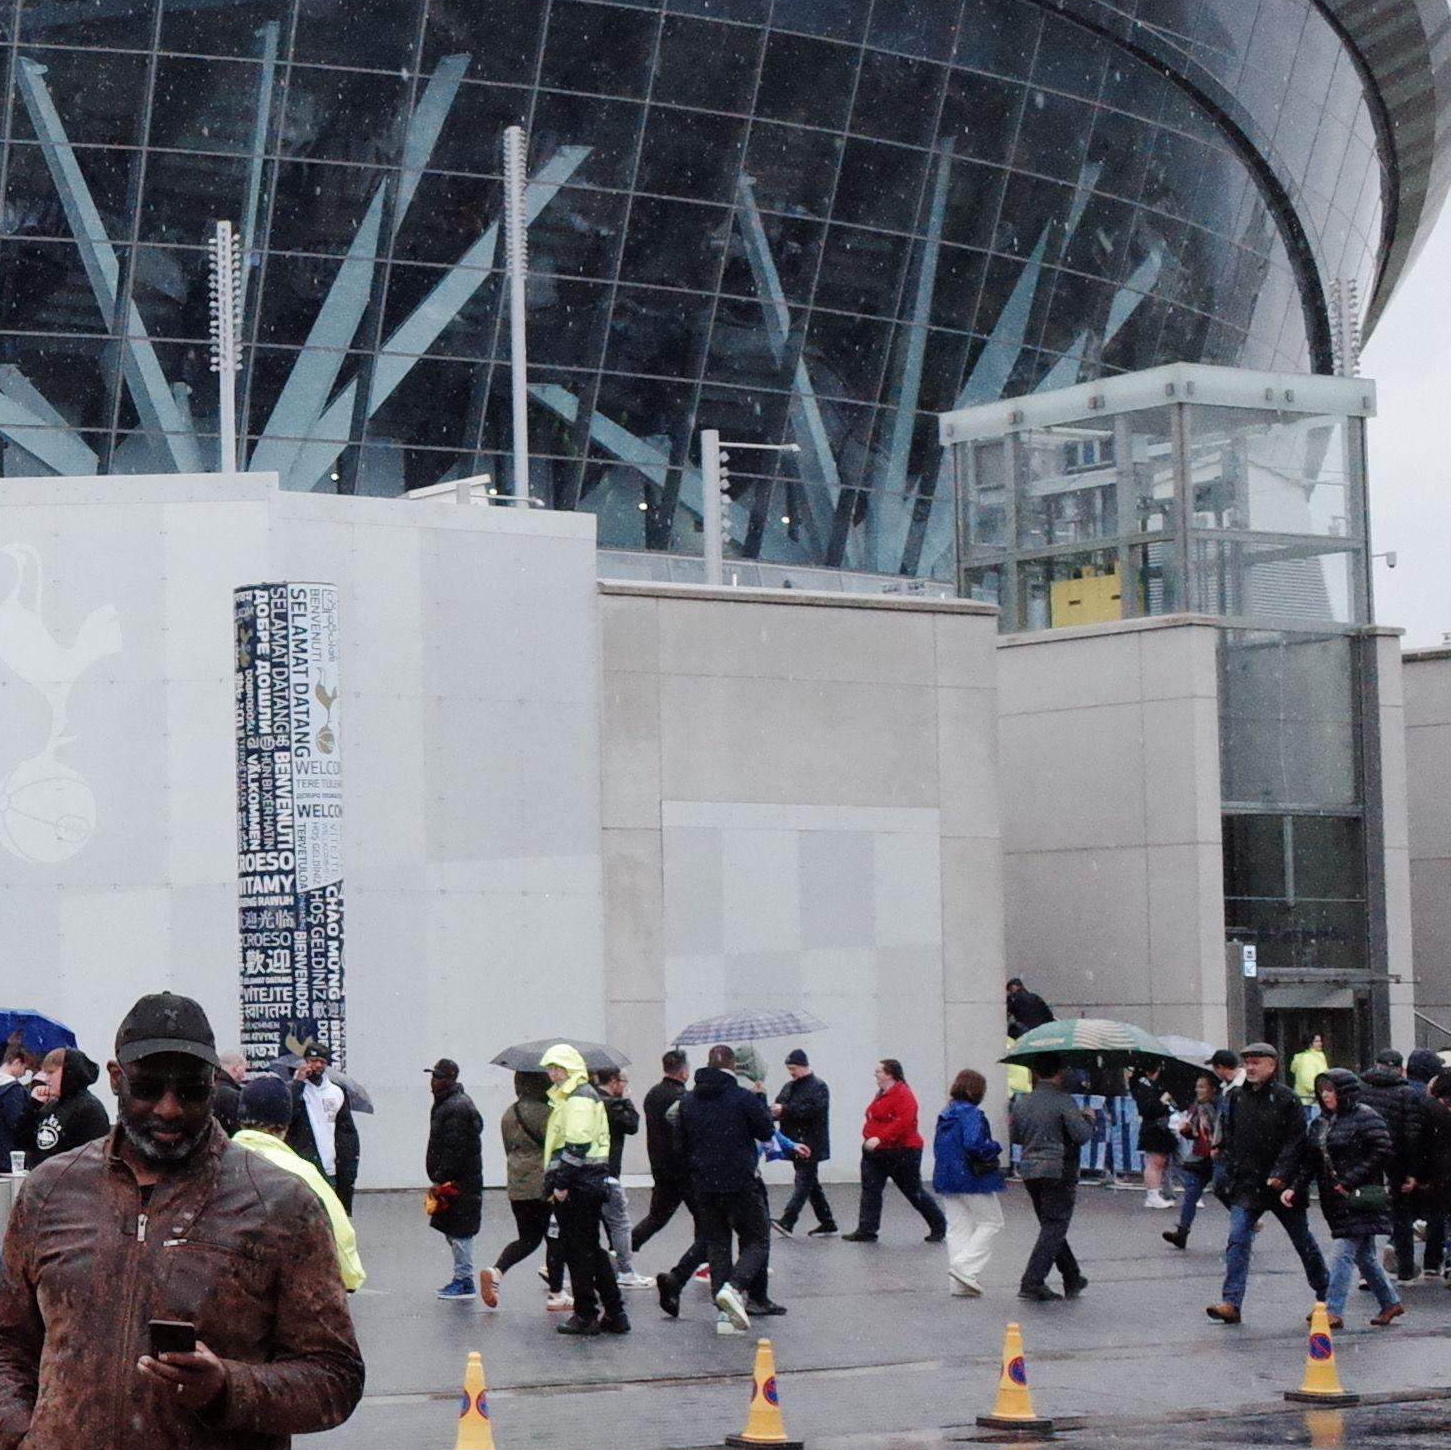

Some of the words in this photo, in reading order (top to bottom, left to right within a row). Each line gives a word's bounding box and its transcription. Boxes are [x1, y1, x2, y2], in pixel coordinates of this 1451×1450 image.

[270, 587, 288, 665] SELAMAT
[290, 588, 309, 678] SELAMAT
[310, 588, 322, 662] BENVENUTI
[271, 667, 290, 733] DATANG
[292, 682, 311, 757] DATANG
[274, 751, 294, 849] BENVENUTI
[296, 804, 343, 818] WELCO
[238, 851, 295, 872] ROESO
[239, 874, 295, 895] ITAMY
[297, 822, 308, 890] TERVETULOA
[293, 931, 309, 1018] BIENVENIDOS
